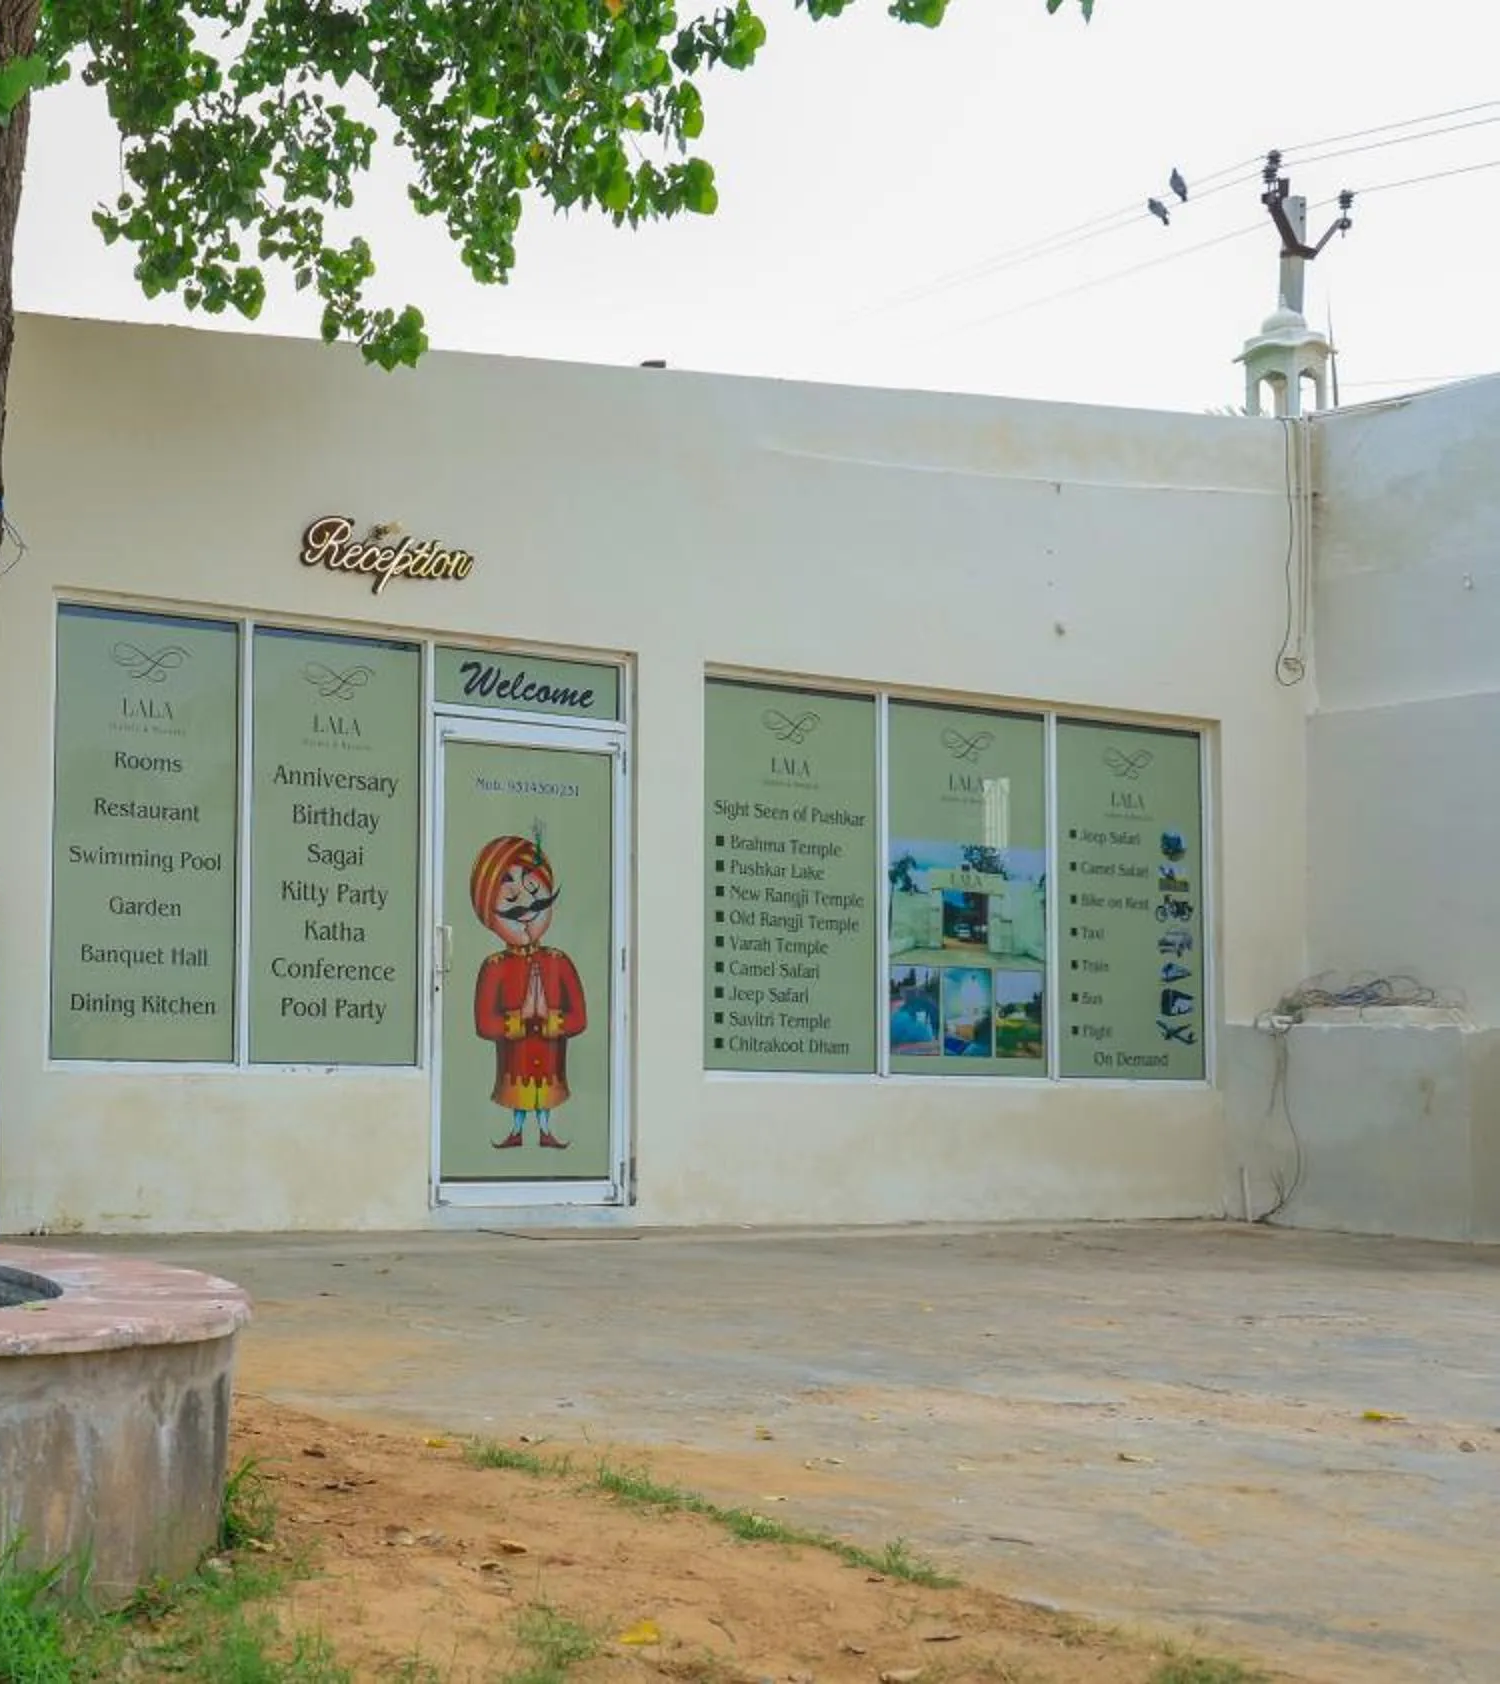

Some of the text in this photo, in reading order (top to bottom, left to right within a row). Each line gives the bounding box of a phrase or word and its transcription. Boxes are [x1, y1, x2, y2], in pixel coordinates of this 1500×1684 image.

[300, 515, 475, 595] Reception
[460, 660, 594, 709] Welcome
[123, 697, 173, 720] LALA
[314, 714, 361, 736] LALA
[114, 751, 183, 773] Rooms
[771, 756, 810, 777] LALA
[273, 765, 399, 799] Anniversary
[94, 798, 199, 823] Restaurant
[292, 804, 381, 834] Birthday
[714, 800, 866, 827] Sight Seen of Pushkar
[68, 845, 221, 872] Swimming Pool
[307, 845, 365, 867] Sagai
[731, 835, 843, 860] Brahma Temple
[730, 859, 825, 881] Pushkar Lake
[108, 897, 182, 917] Garden
[280, 881, 388, 910] Kitty Party
[729, 885, 761, 901] New
[814, 890, 865, 910] Temple
[304, 920, 366, 943] Katha
[729, 909, 755, 925] Old
[808, 915, 860, 935] Temple
[80, 944, 208, 970] Banquet Hall
[729, 936, 829, 958] Varah Temple
[271, 957, 396, 982] Conference
[729, 960, 820, 979] Camel Safari
[69, 994, 216, 1017] Dining Kitchen
[728, 986, 809, 1005] Jeep Safari
[281, 996, 387, 1024] Pool Party
[729, 1011, 832, 1032] Savitri Temple
[729, 1035, 850, 1055] Chitrakoot Dham
[1093, 1051, 1169, 1067] On Demand
